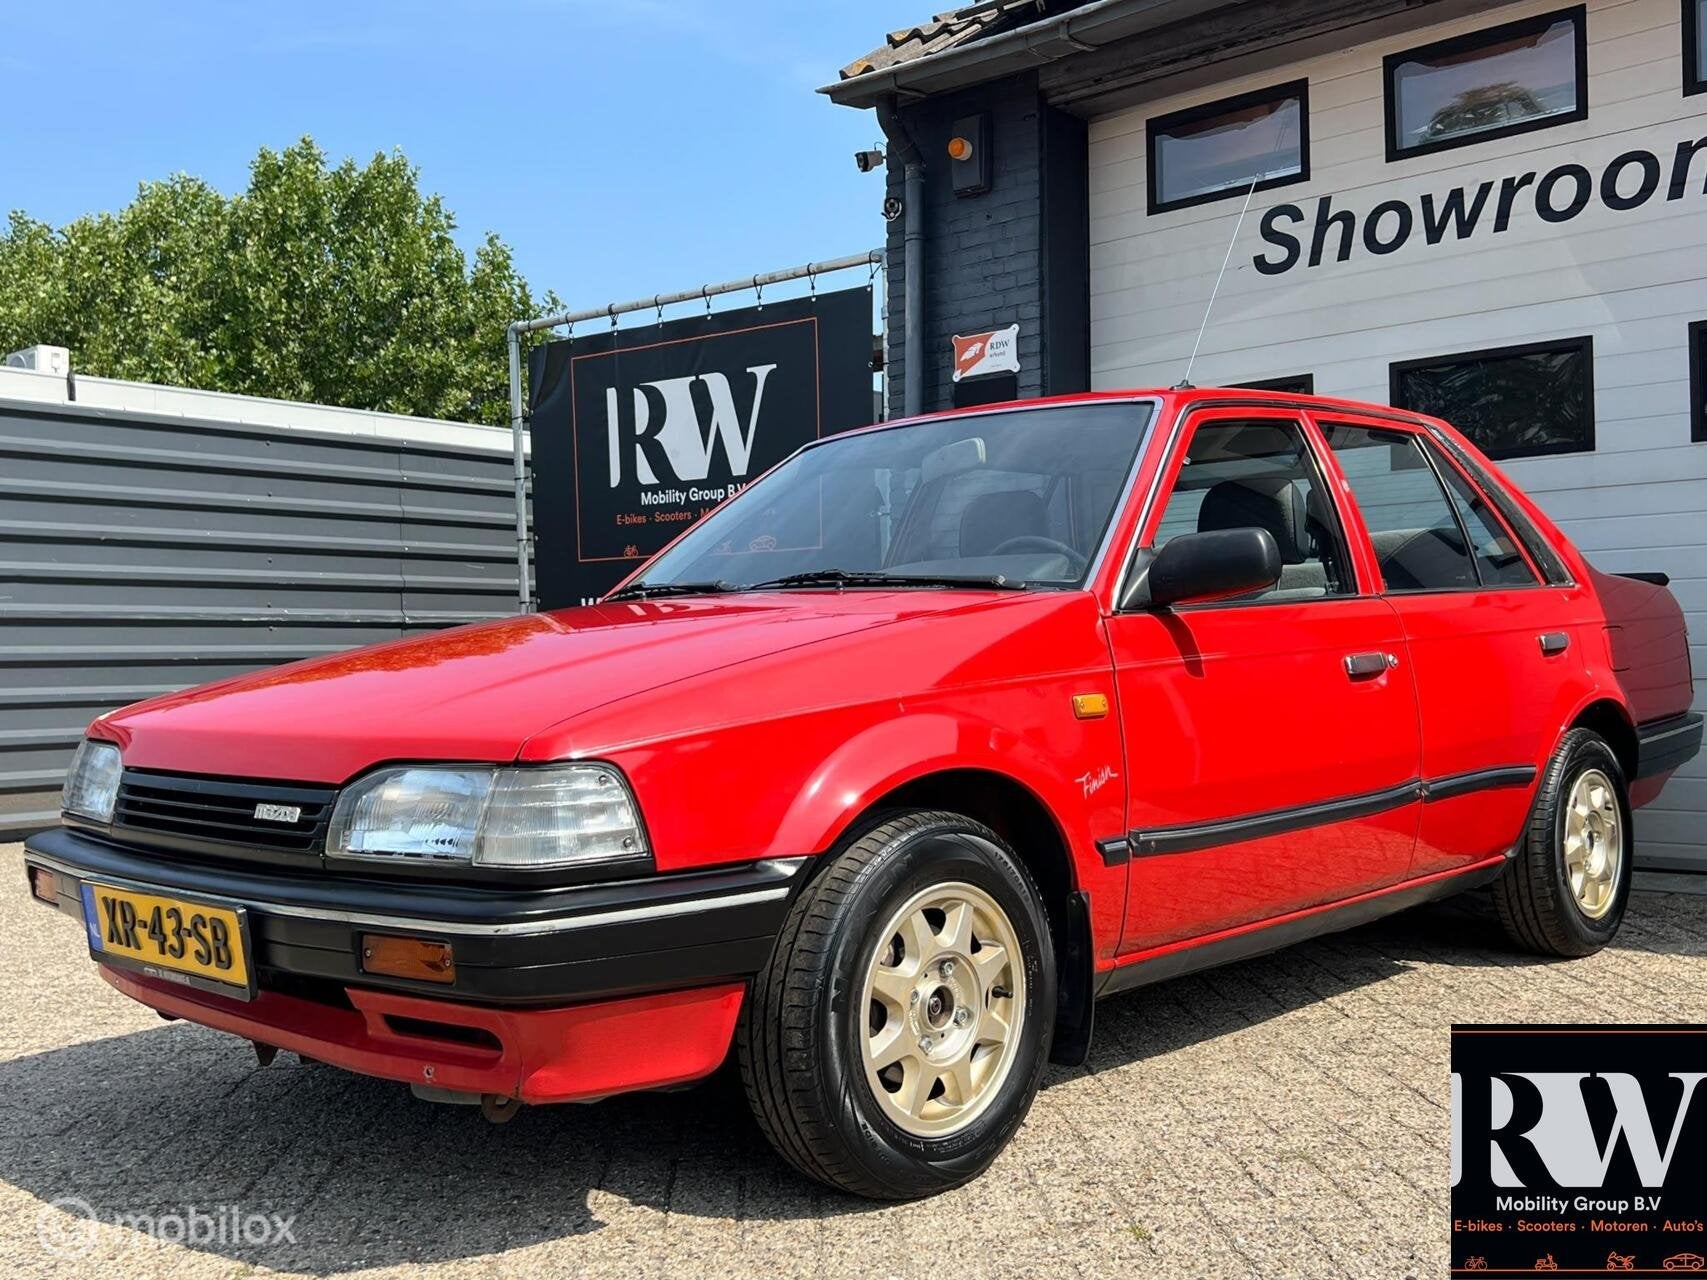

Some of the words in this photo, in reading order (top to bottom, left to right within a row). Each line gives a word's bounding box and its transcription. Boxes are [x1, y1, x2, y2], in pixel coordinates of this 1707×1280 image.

[990, 339, 1010, 350] RDW
[641, 489, 687, 505] Mobility
[689, 487, 725, 501] Group
[616, 513, 647, 525] E-bikes
[654, 510, 692, 523] Scooters
[89, 922, 100, 938] NL
[101, 896, 232, 970] XR-43-SB
